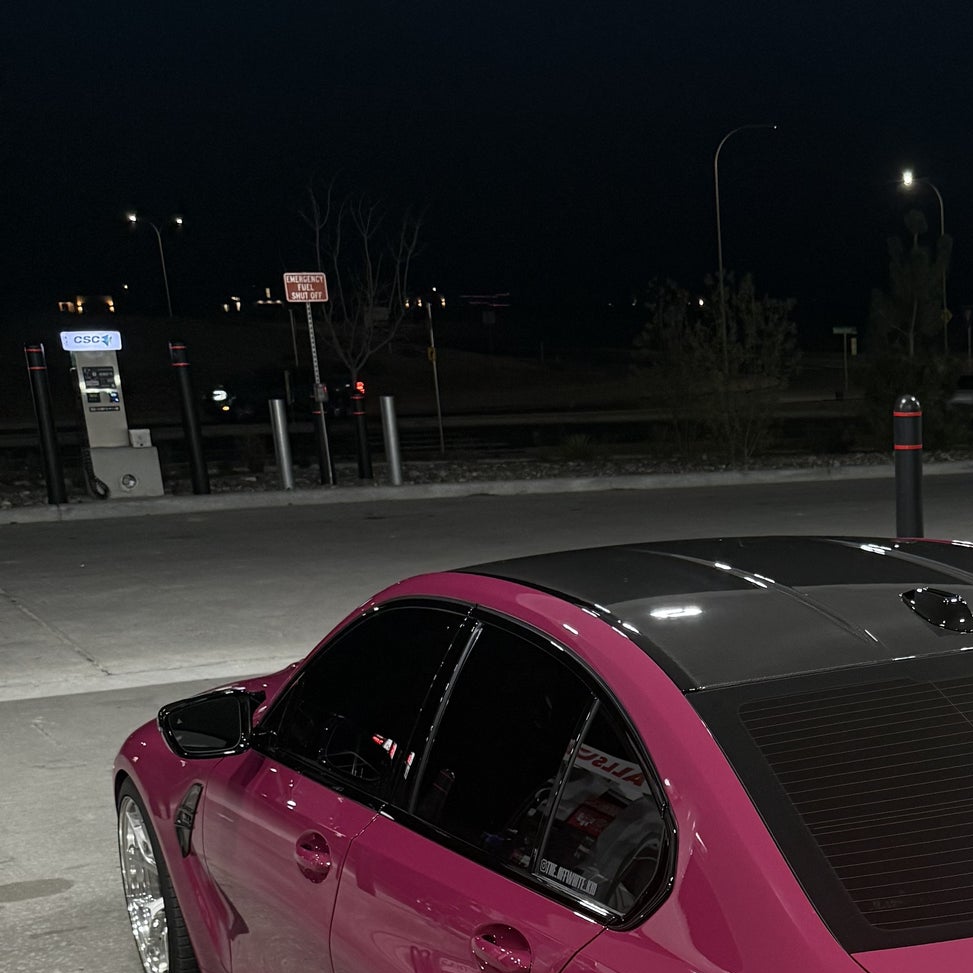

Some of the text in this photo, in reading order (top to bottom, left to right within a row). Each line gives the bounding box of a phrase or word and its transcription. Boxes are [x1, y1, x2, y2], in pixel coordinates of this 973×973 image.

[286, 275, 324, 284] EMERGENCY
[297, 283, 315, 292] FUEL
[291, 291, 309, 300] SHUT
[73, 336, 101, 344] CSC
